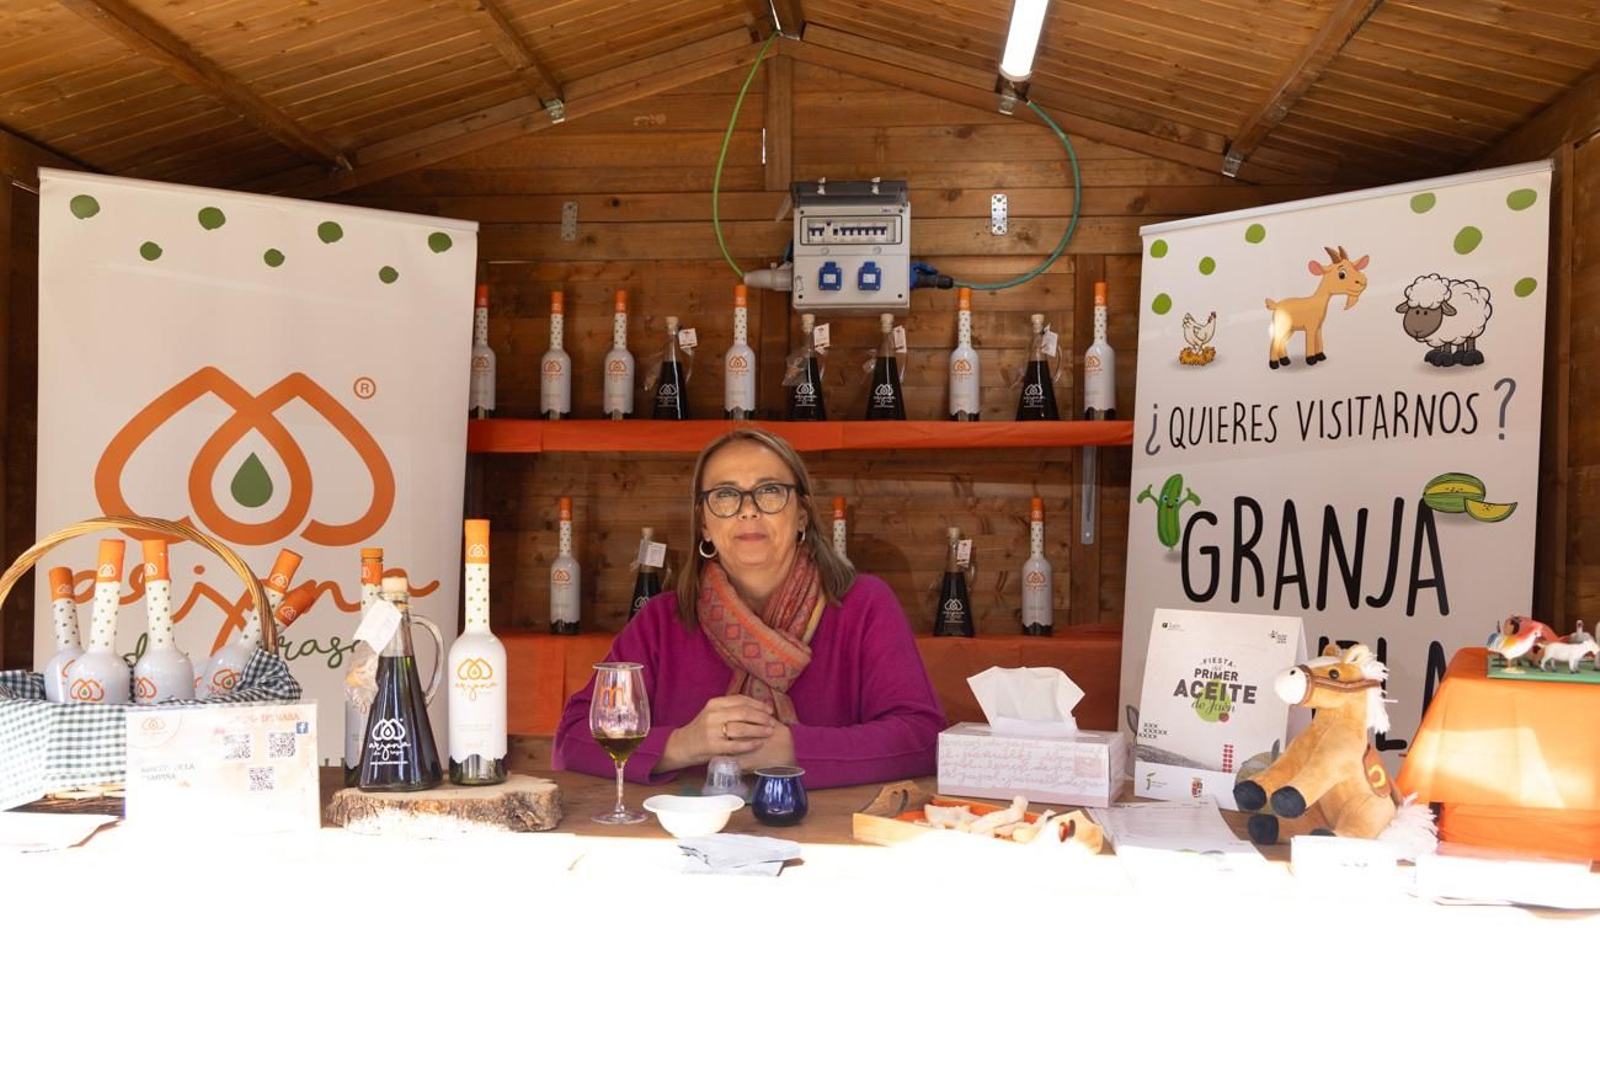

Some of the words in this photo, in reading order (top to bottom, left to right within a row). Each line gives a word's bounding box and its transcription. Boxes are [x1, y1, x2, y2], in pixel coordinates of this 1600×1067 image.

[1181, 495, 1450, 617] GRANJA
[1203, 657, 1234, 667] FIESTA
[1194, 668, 1239, 682] PRIMER
[1173, 679, 1258, 705] ACEITE
